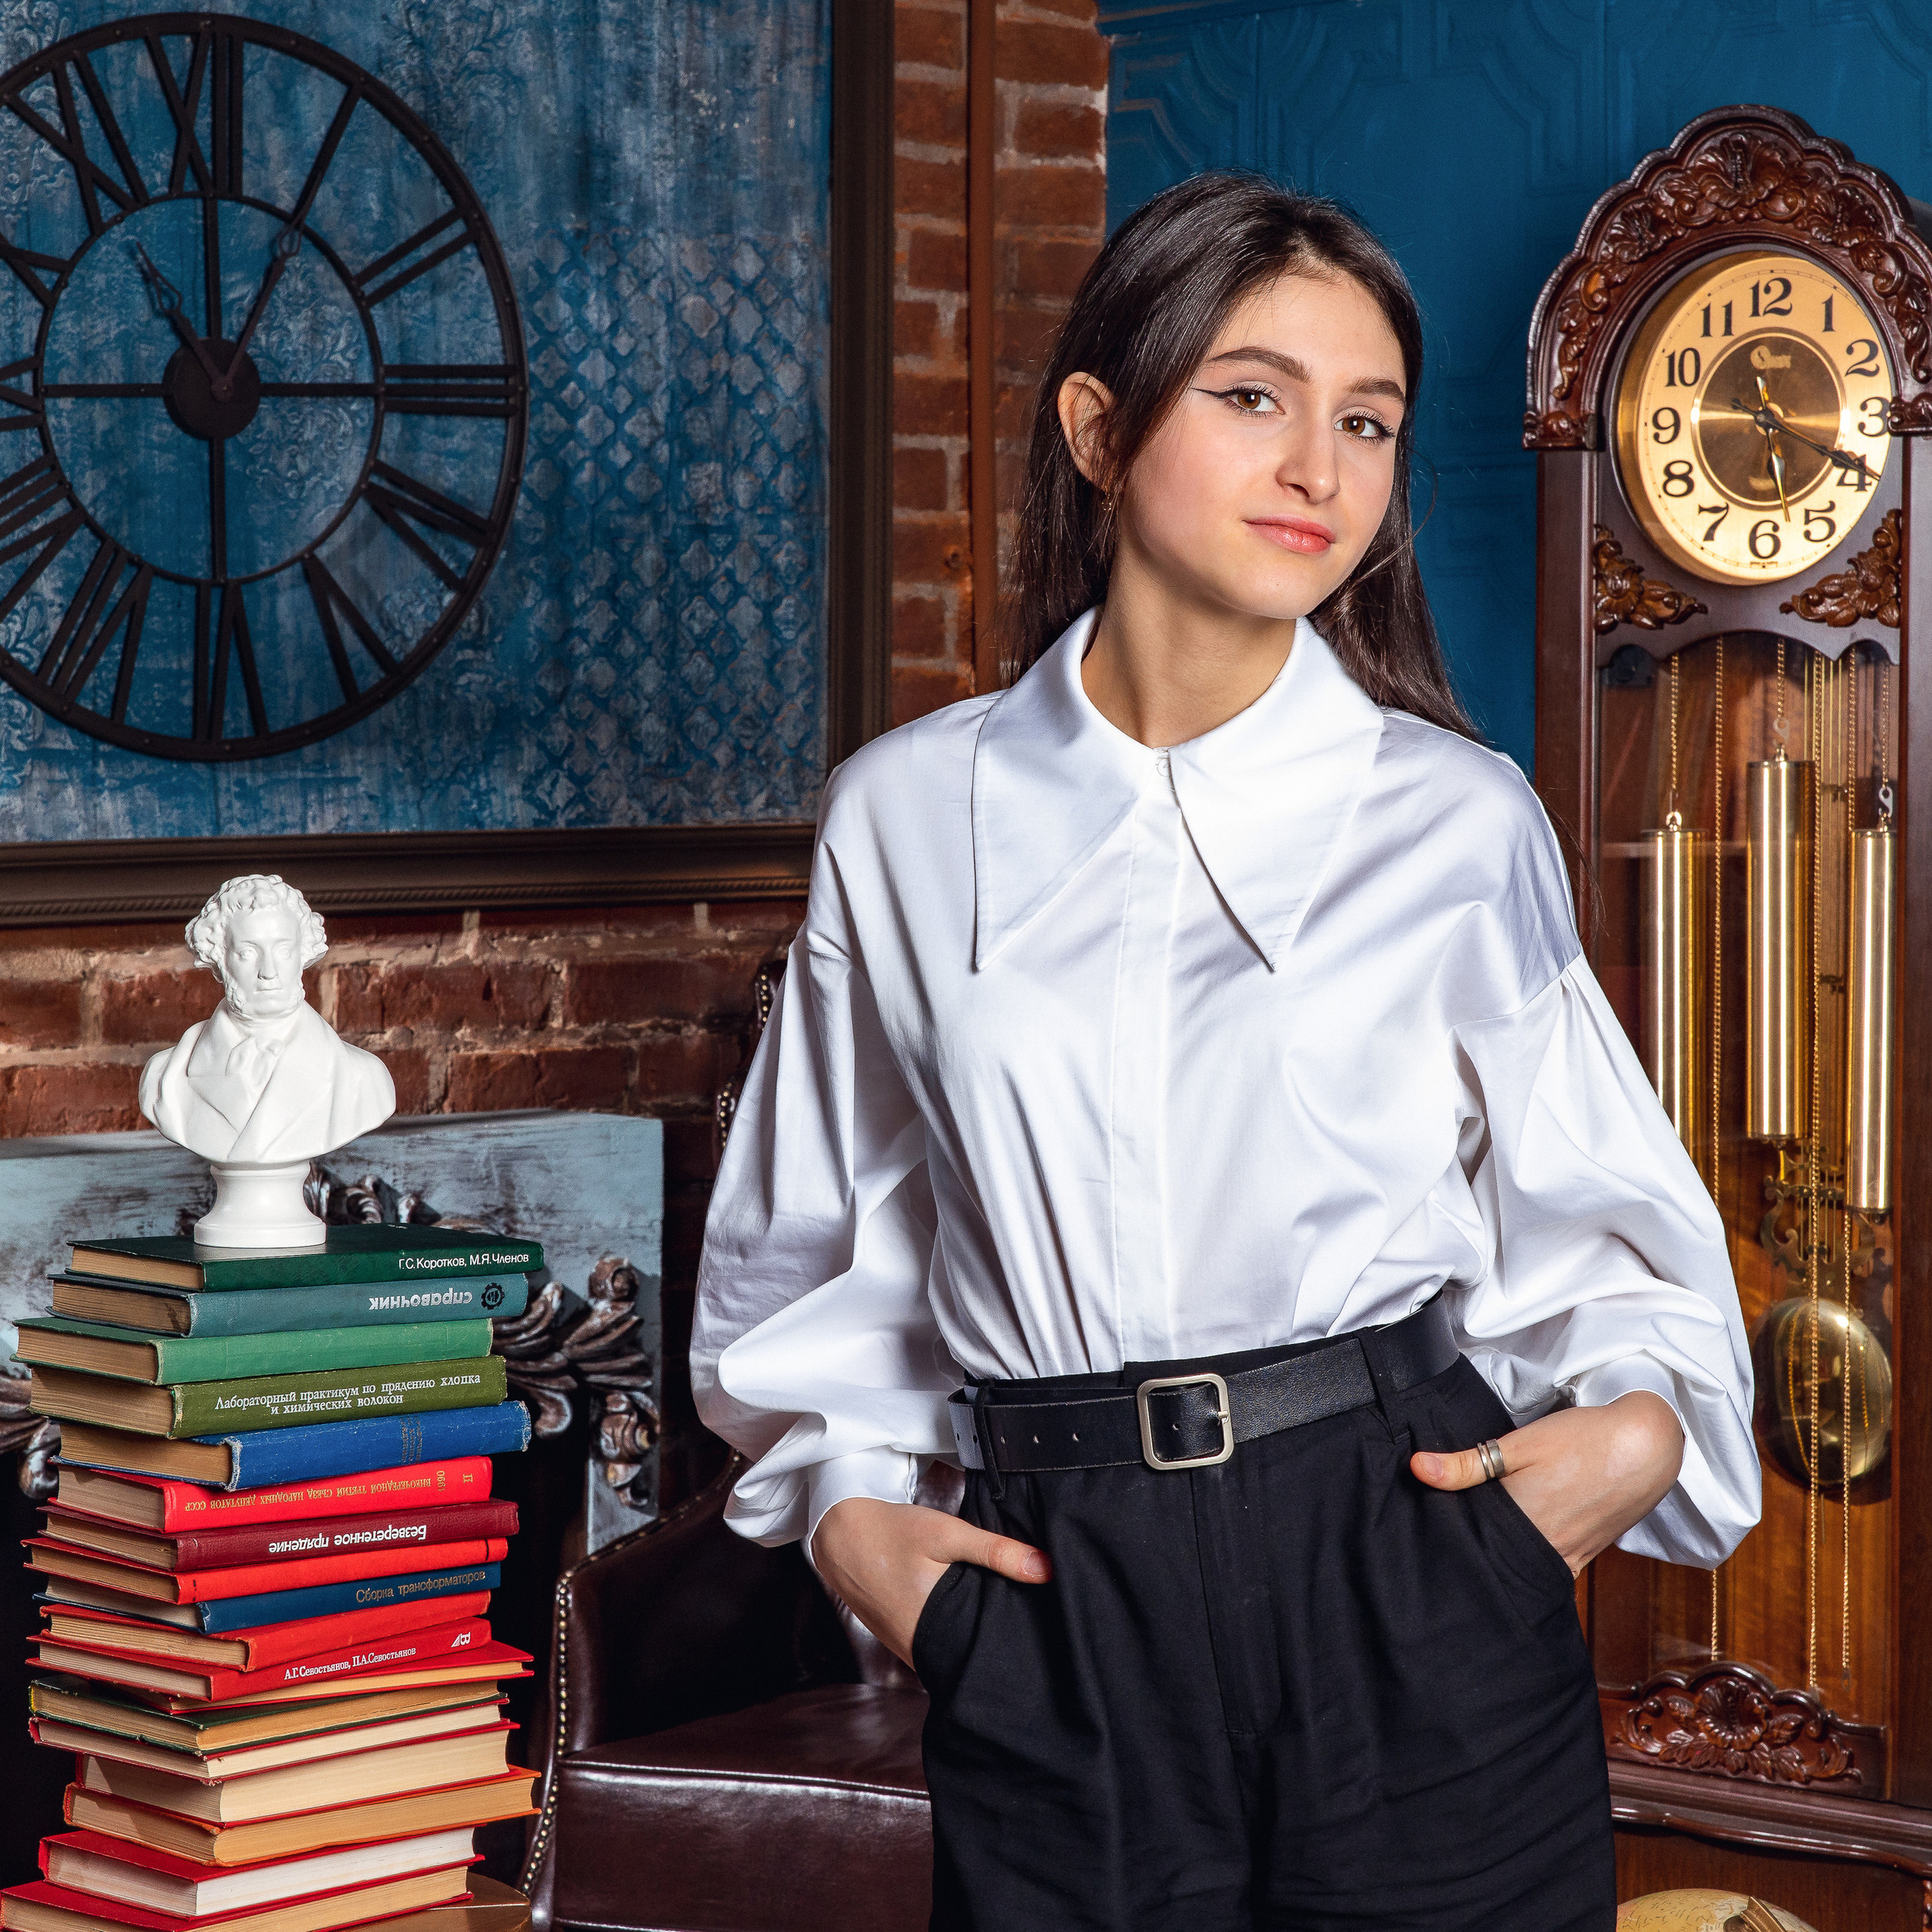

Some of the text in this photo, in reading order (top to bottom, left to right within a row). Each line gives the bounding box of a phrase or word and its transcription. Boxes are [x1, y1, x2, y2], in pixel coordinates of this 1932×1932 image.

[1749, 276, 1793, 318] 12
[1822, 294, 1836, 333] 1
[1701, 300, 1734, 338] 11
[1666, 347, 1701, 387] 10
[1845, 338, 1880, 377] 2
[1652, 407, 1681, 445] 9
[1858, 397, 1890, 438] 3
[1663, 460, 1695, 497] 8
[1837, 453, 1873, 493] 4
[1698, 501, 1729, 542] 7
[1749, 520, 1781, 559] 6
[1804, 500, 1836, 543] 5
[368, 1287, 473, 1311] справочник
[214, 1374, 481, 1411] Лабораторный практикум по прядению хлопка
[270, 1395, 404, 1415] и химических волокон
[185, 1477, 432, 1512] ВНЕОЧЕРЕДНОЙ ТРЕТИЙ СЪЕЗД НАРОДНЫХ ДЕПУТАТОВ СССР
[436, 1470, 445, 1492] 1990
[269, 1524, 427, 1553] Безверетенное прядение
[355, 1571, 486, 1603] Сборка трансформаторов
